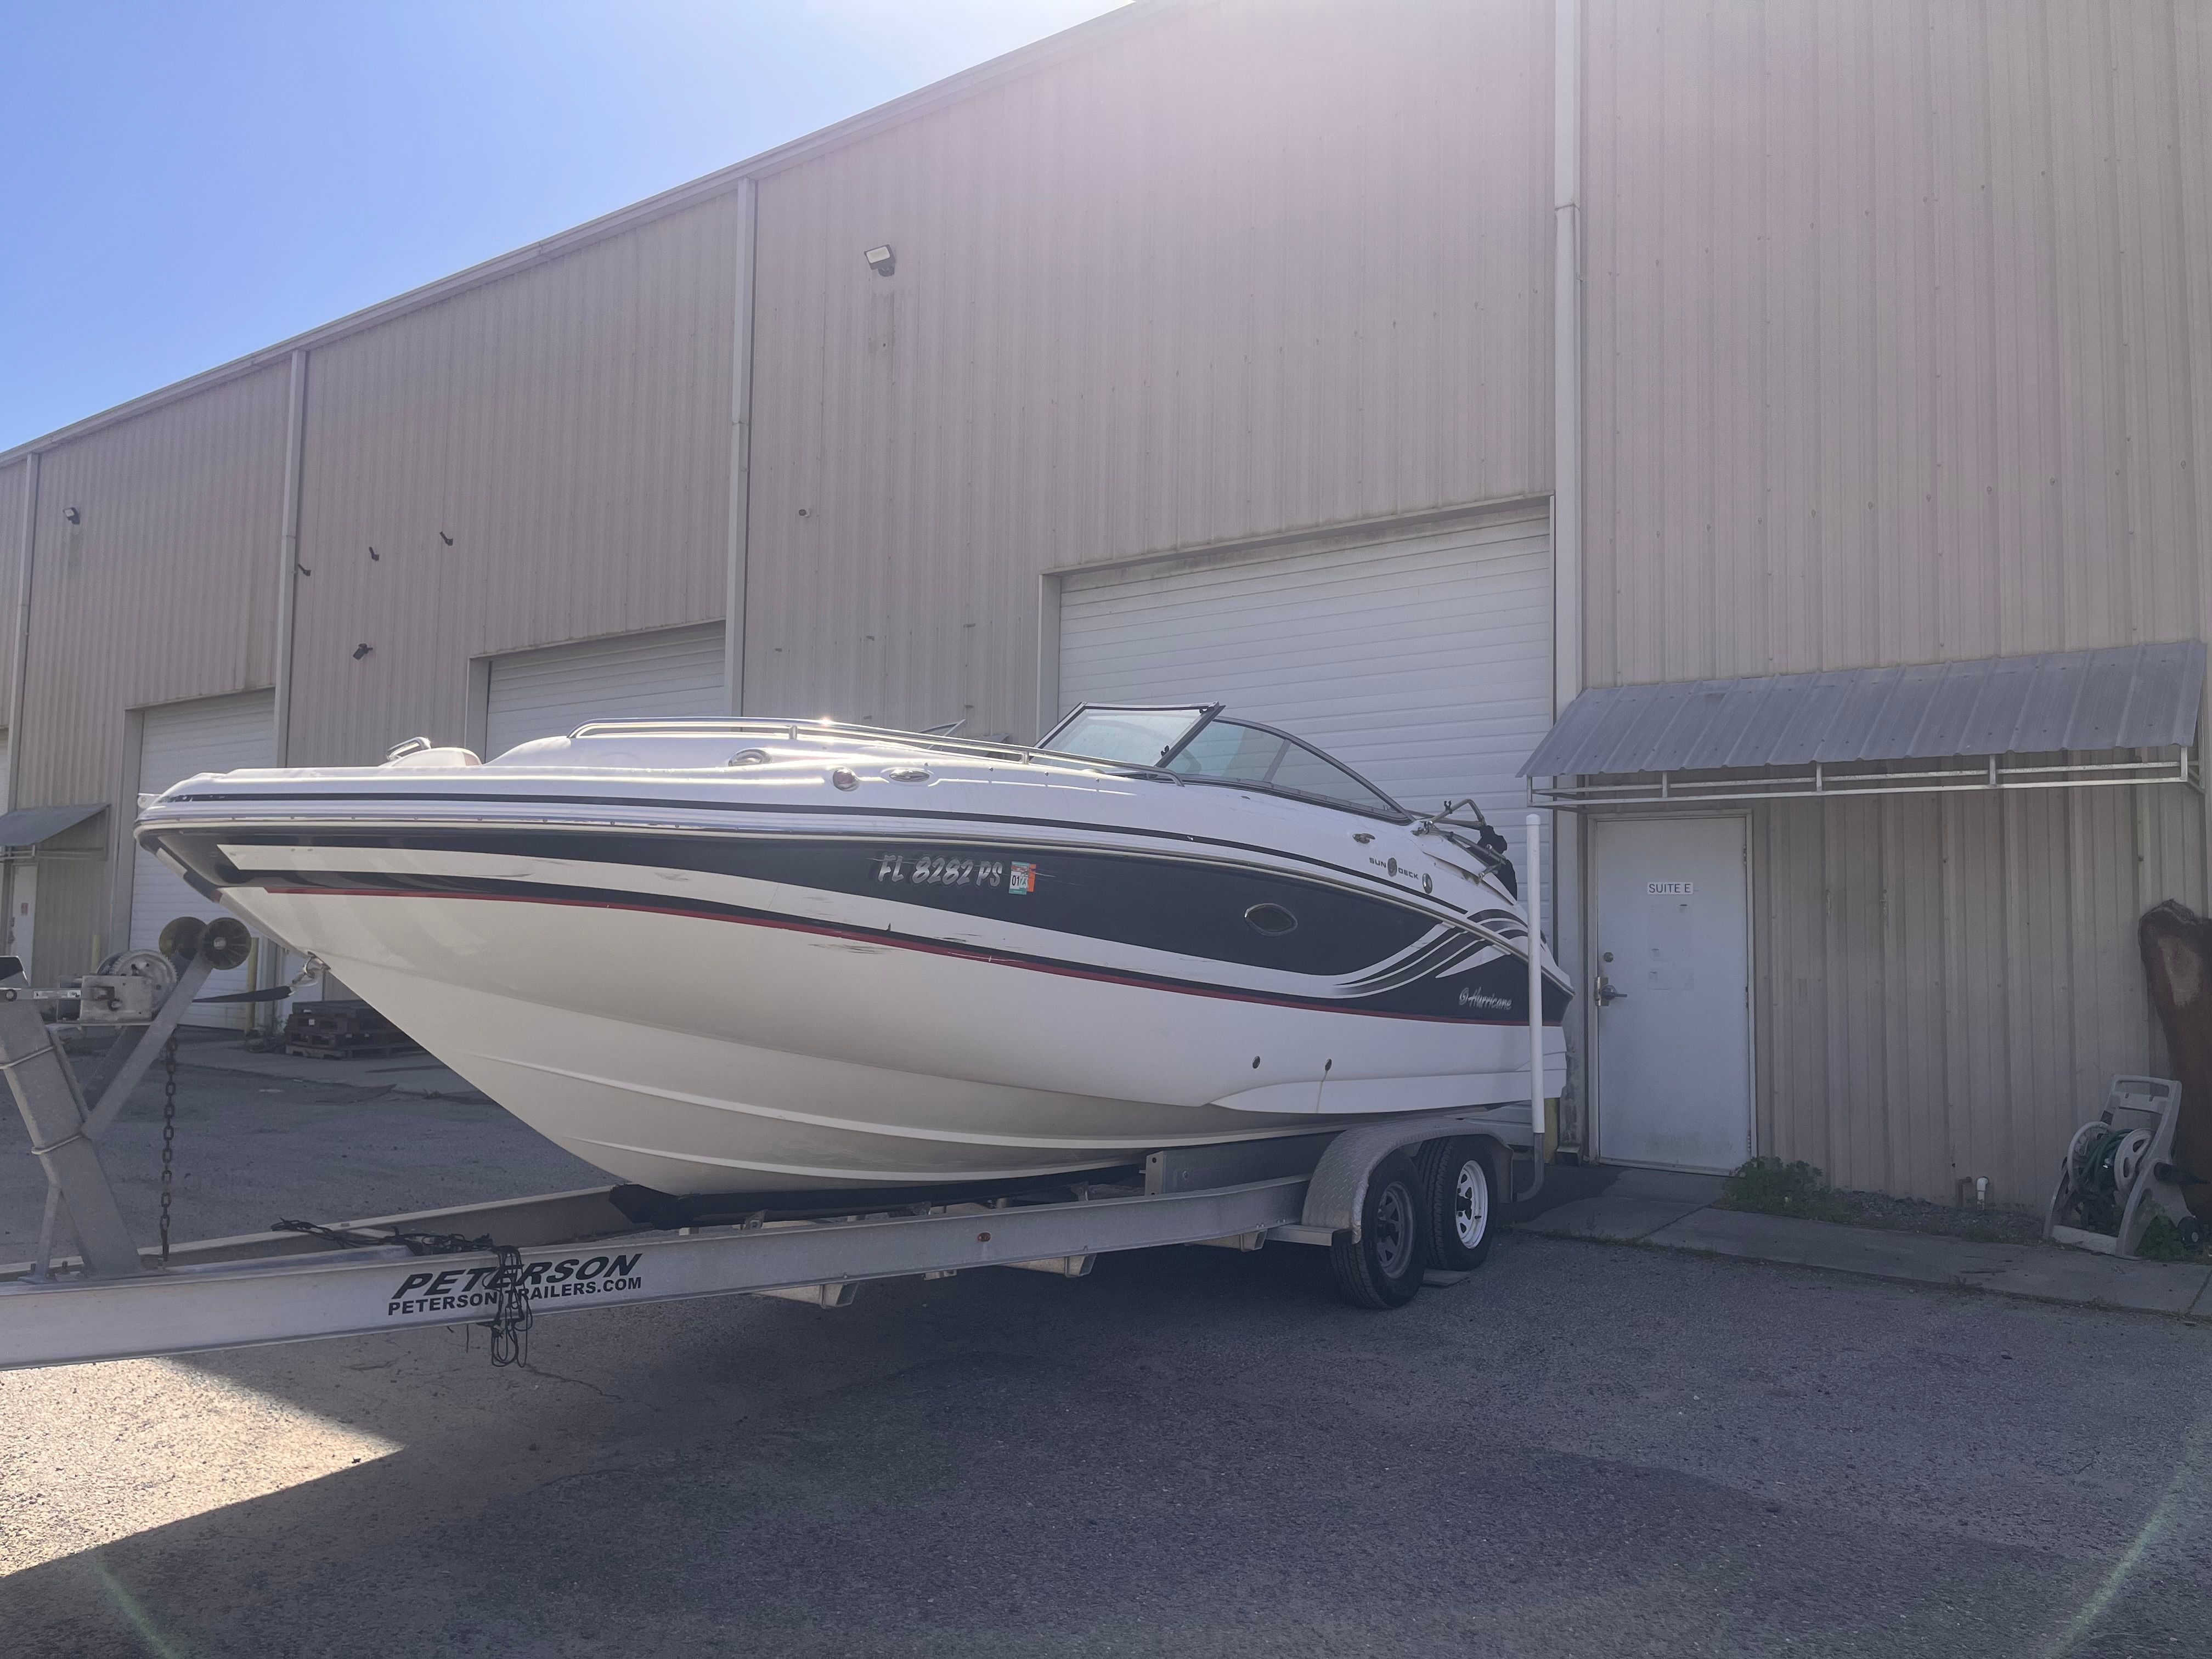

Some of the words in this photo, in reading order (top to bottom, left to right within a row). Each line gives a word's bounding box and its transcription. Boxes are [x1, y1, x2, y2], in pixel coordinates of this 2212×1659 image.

[878, 854, 905, 882] FL
[912, 856, 974, 885] 8282
[976, 861, 1003, 887] PS
[1369, 857, 1386, 868] SUN
[1398, 867, 1419, 879] DECK
[1012, 875, 1019, 886] 01
[1649, 884, 1680, 893] SUITE
[1684, 884, 1691, 893] E
[1468, 986, 1512, 1010] Hurricane
[392, 1253, 643, 1300] PETERSON
